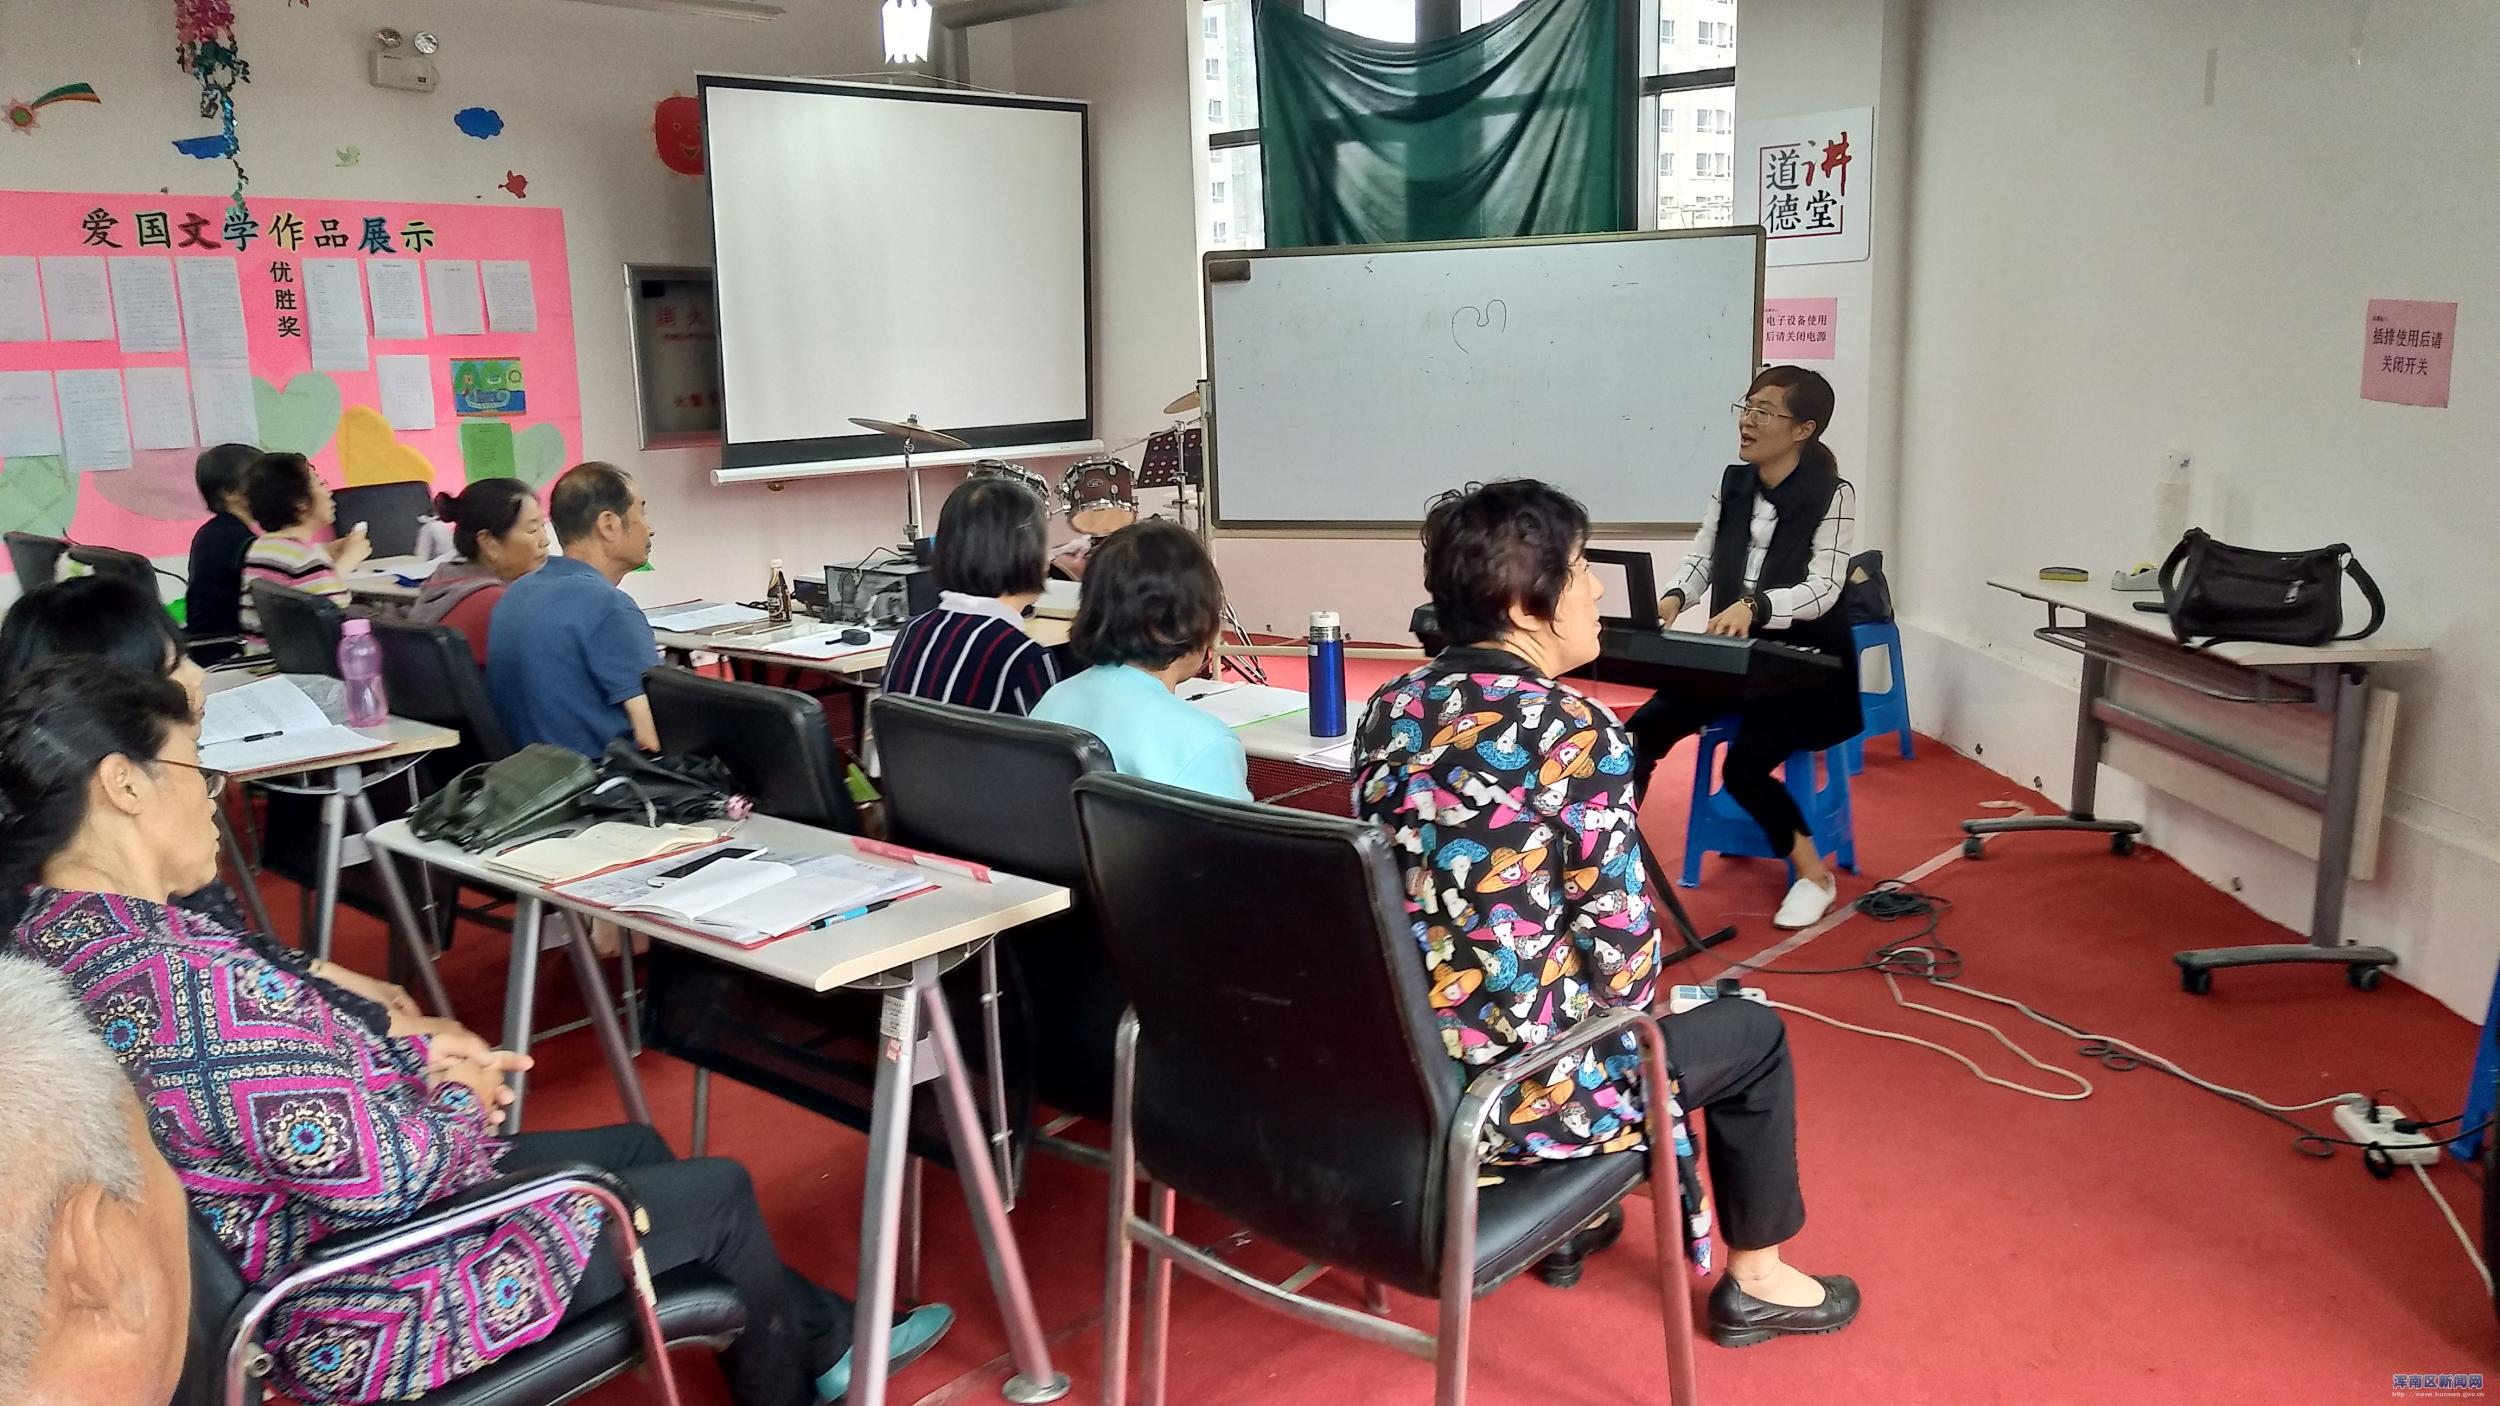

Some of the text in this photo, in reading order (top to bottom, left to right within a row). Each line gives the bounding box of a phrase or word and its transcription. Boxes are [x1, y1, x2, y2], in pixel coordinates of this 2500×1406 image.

[82, 207, 434, 254] 爱国文学作品展示
[270, 261, 301, 338] 优胜奖
[1766, 315, 1827, 326] 电子设备使用
[1766, 331, 1827, 342] 后请关闭电源
[2382, 355, 2428, 375] 关闭开关
